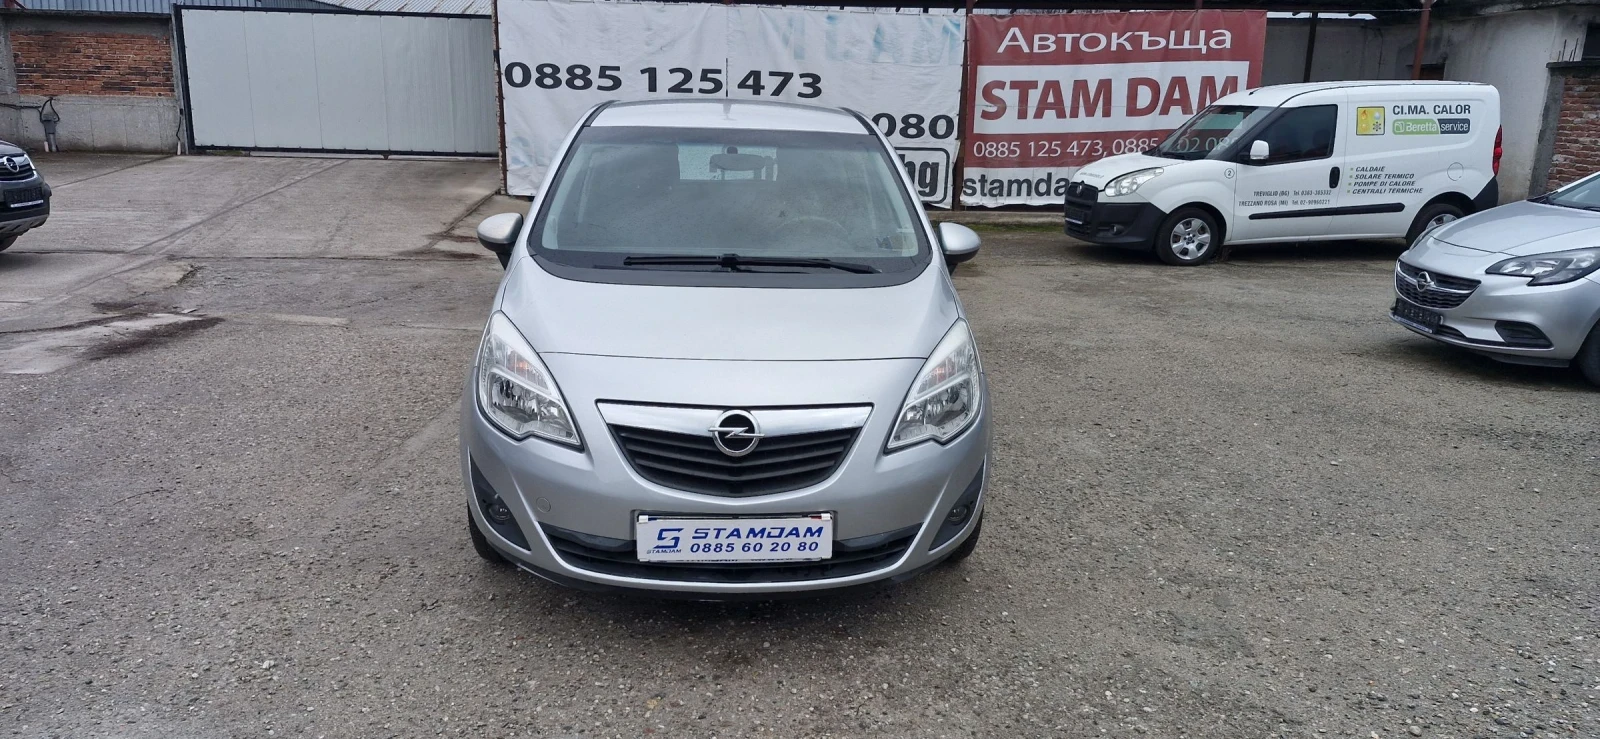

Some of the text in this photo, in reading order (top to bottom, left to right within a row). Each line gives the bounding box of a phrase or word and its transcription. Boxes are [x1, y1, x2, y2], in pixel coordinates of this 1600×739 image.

[997, 27, 1232, 54] Автокъща
[504, 62, 822, 98] 0885 125 473
[980, 76, 1238, 121] STAM DAM
[1392, 104, 1471, 115] CI.MA. CALOR
[872, 113, 954, 139] 080
[1405, 121, 1469, 132] Beretta service
[974, 141, 1020, 158] 0885
[1028, 141, 1061, 157] 125
[1066, 139, 1107, 159] 473,
[1112, 137, 1159, 154] 0885
[962, 173, 1070, 198] stamda
[690, 541, 819, 553] 0885 60 20 80
